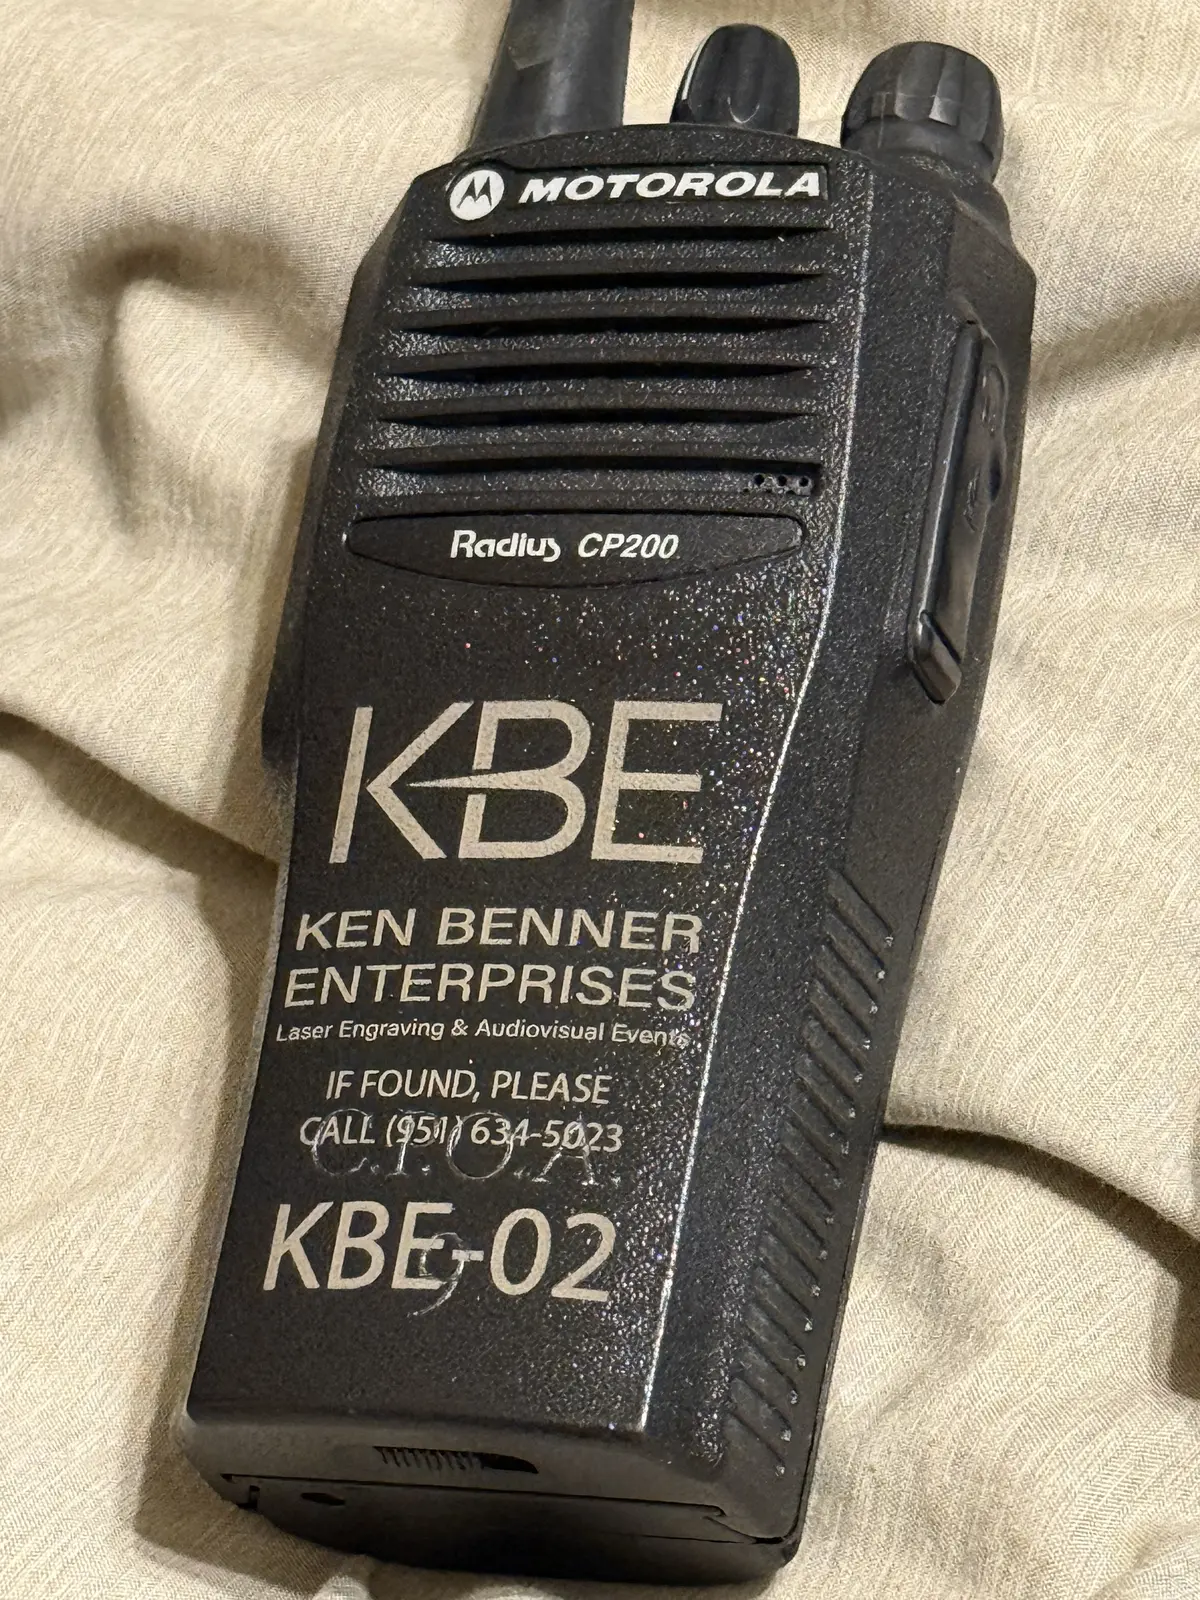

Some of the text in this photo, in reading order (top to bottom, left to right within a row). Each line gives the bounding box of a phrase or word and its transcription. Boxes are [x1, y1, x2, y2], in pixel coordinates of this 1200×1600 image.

[518, 171, 821, 204] MOTOROLA
[450, 529, 680, 563] Radius CP200
[328, 699, 724, 865] KBE
[294, 906, 703, 954] KEN BENNER
[283, 962, 697, 1012] ENTERPRISES
[275, 1018, 692, 1049] Laser Engraving & Audiovisual Events
[325, 1069, 613, 1105] IF FOUND, PLEASE
[300, 1114, 624, 1153] CALL (951) 634-5023
[262, 1200, 618, 1303] KBE-02
